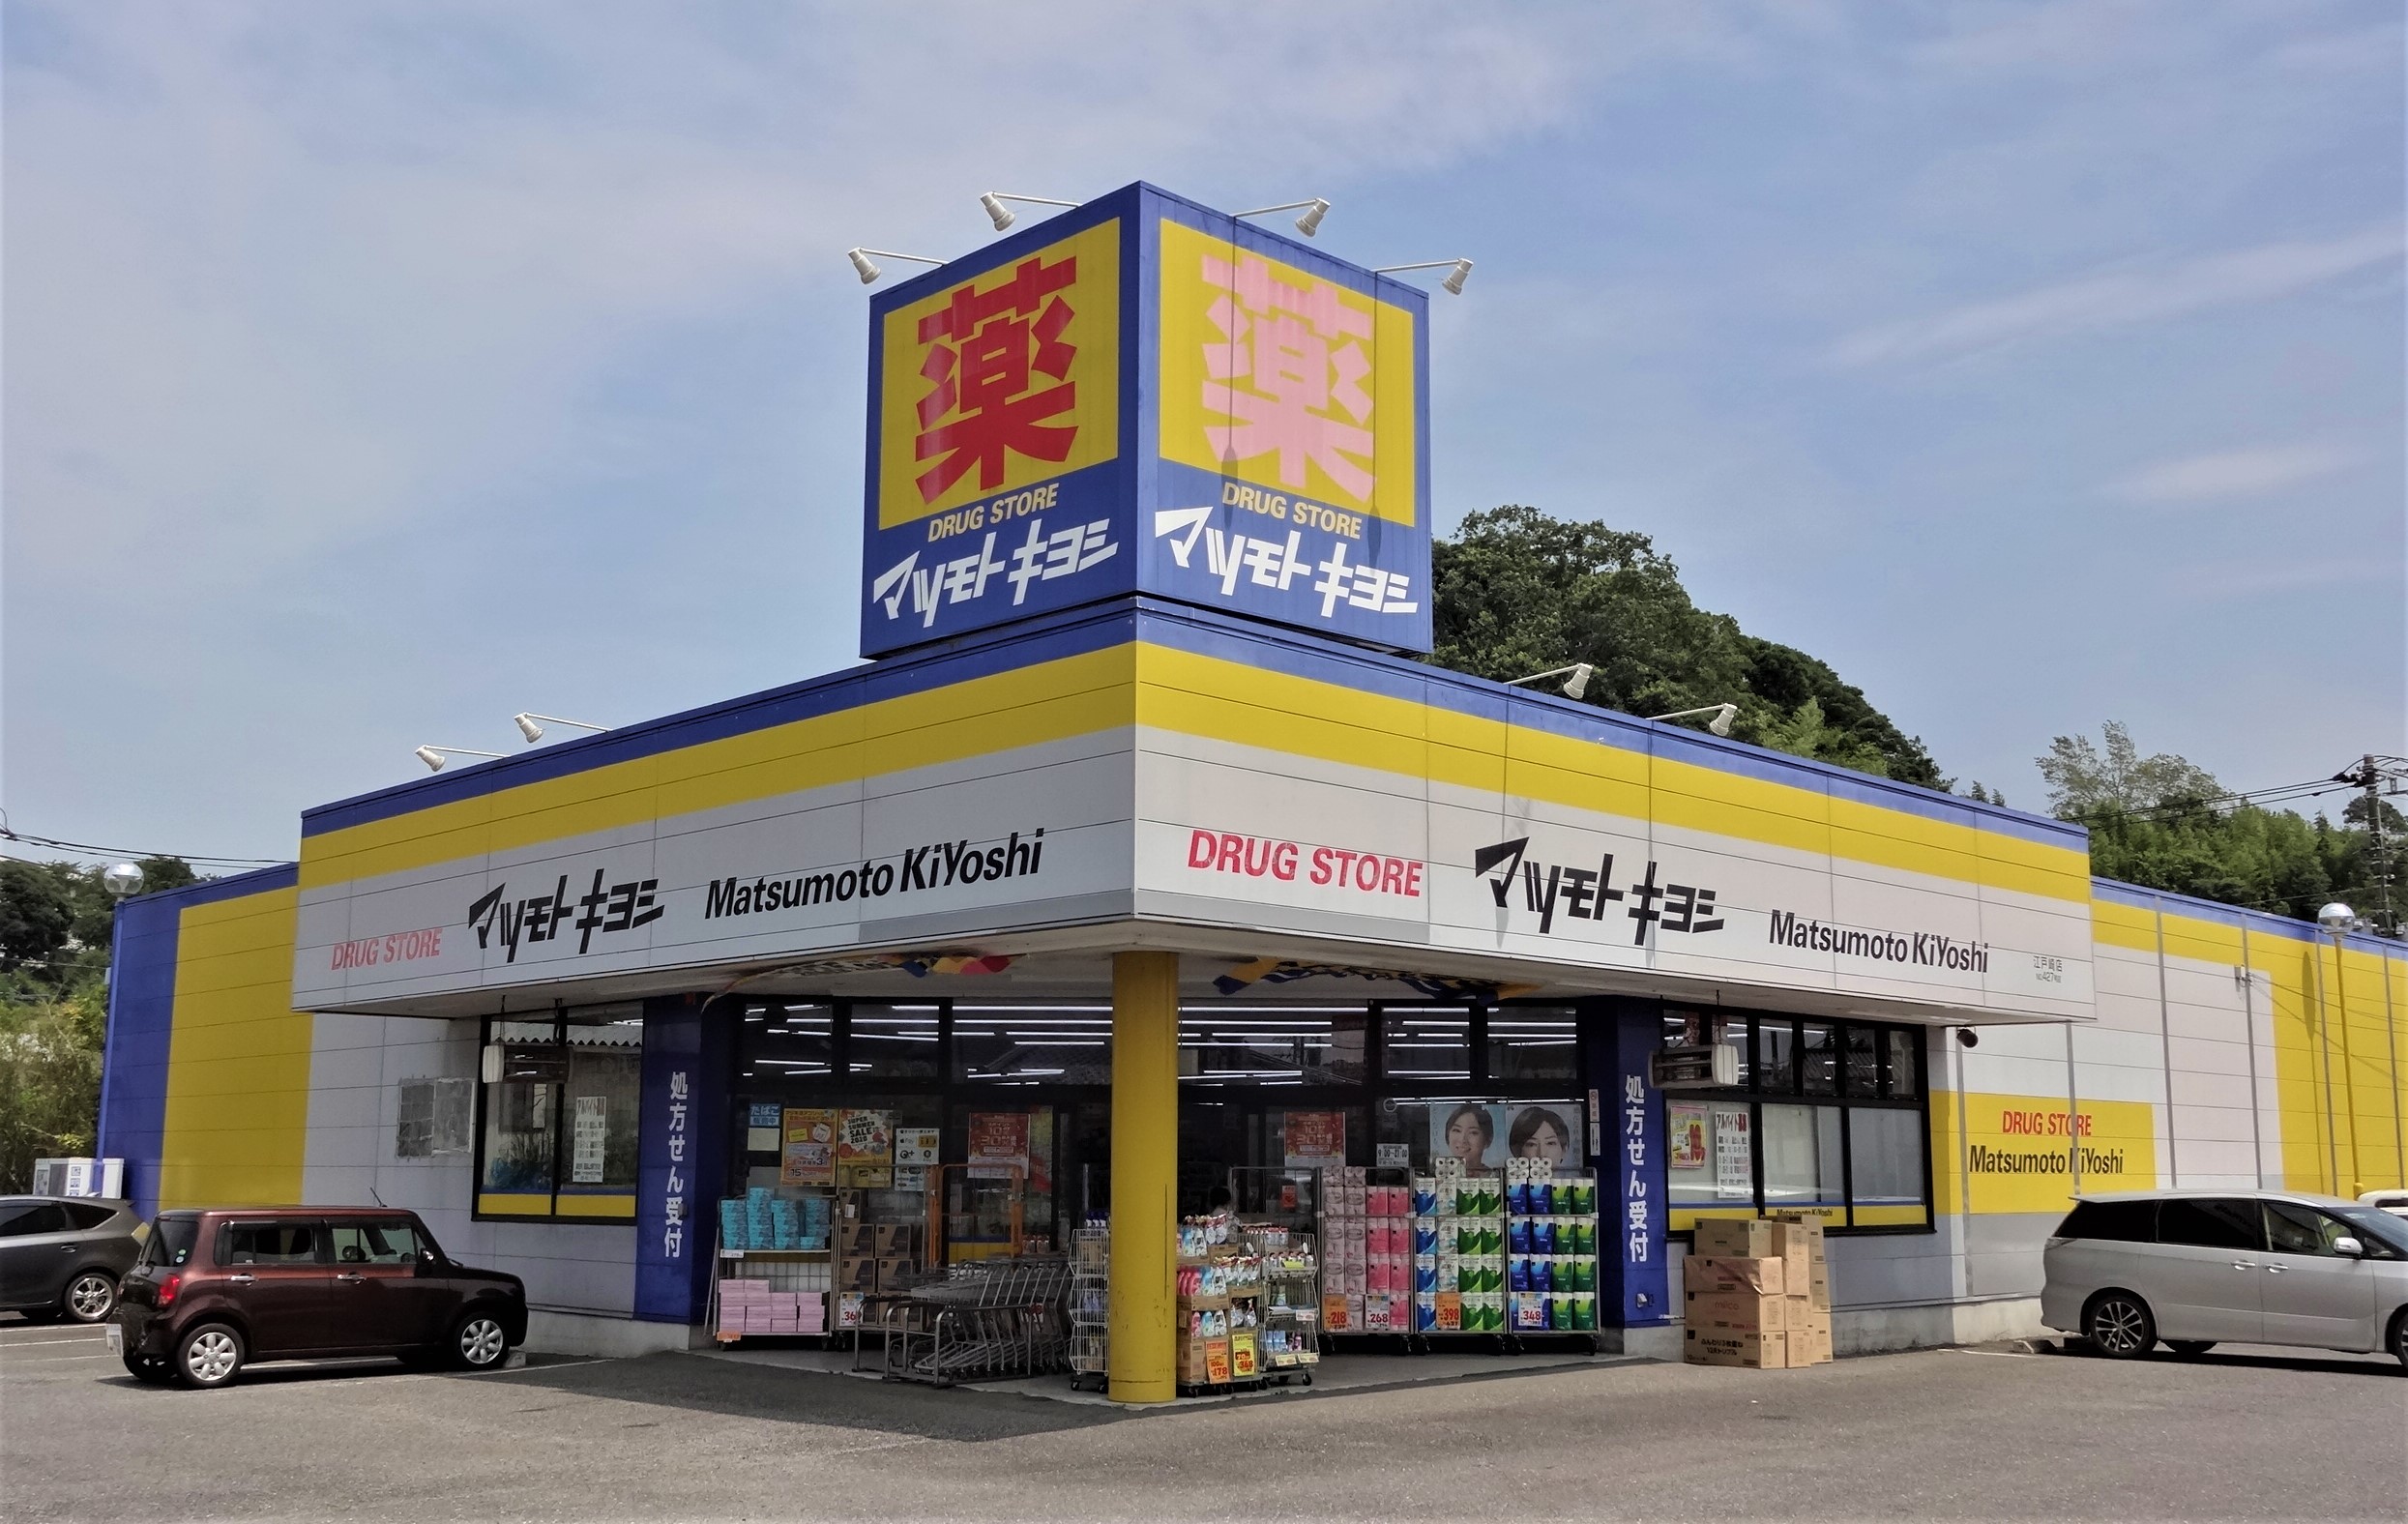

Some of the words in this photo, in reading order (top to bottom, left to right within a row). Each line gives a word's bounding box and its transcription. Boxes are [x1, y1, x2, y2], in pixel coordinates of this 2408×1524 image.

[915, 255, 1079, 505] 薬
[1201, 253, 1378, 504] 薬
[927, 503, 984, 543] DRUG
[988, 482, 1060, 524] STORE
[1221, 482, 1287, 521] DRUG
[1292, 503, 1363, 541] STORE
[704, 861, 895, 921] Matsumoto
[898, 826, 1045, 894] KiYoshi
[1188, 828, 1300, 881] DRUG
[1308, 844, 1424, 898] STORE
[331, 936, 381, 971] DRUG
[383, 926, 443, 964] STORE
[1769, 908, 1909, 963] Matsumoto
[1912, 929, 1989, 975] KiYoshi
[750, 1105, 779, 1116] たばこ
[849, 1127, 873, 1138] SALE
[2002, 1110, 2043, 1135] DRUG
[2047, 1112, 2093, 1136] STORE
[663, 1071, 689, 1258] 処方せん受付
[1625, 1074, 1649, 1263] 処方せん受付
[1969, 1144, 2066, 1174] Matsumoto
[844, 1311, 860, 1321] 36
[1330, 1311, 1347, 1324] 218
[1369, 1313, 1389, 1324] 268
[1443, 1307, 1459, 1321] 398
[1523, 1310, 1542, 1321] 348
